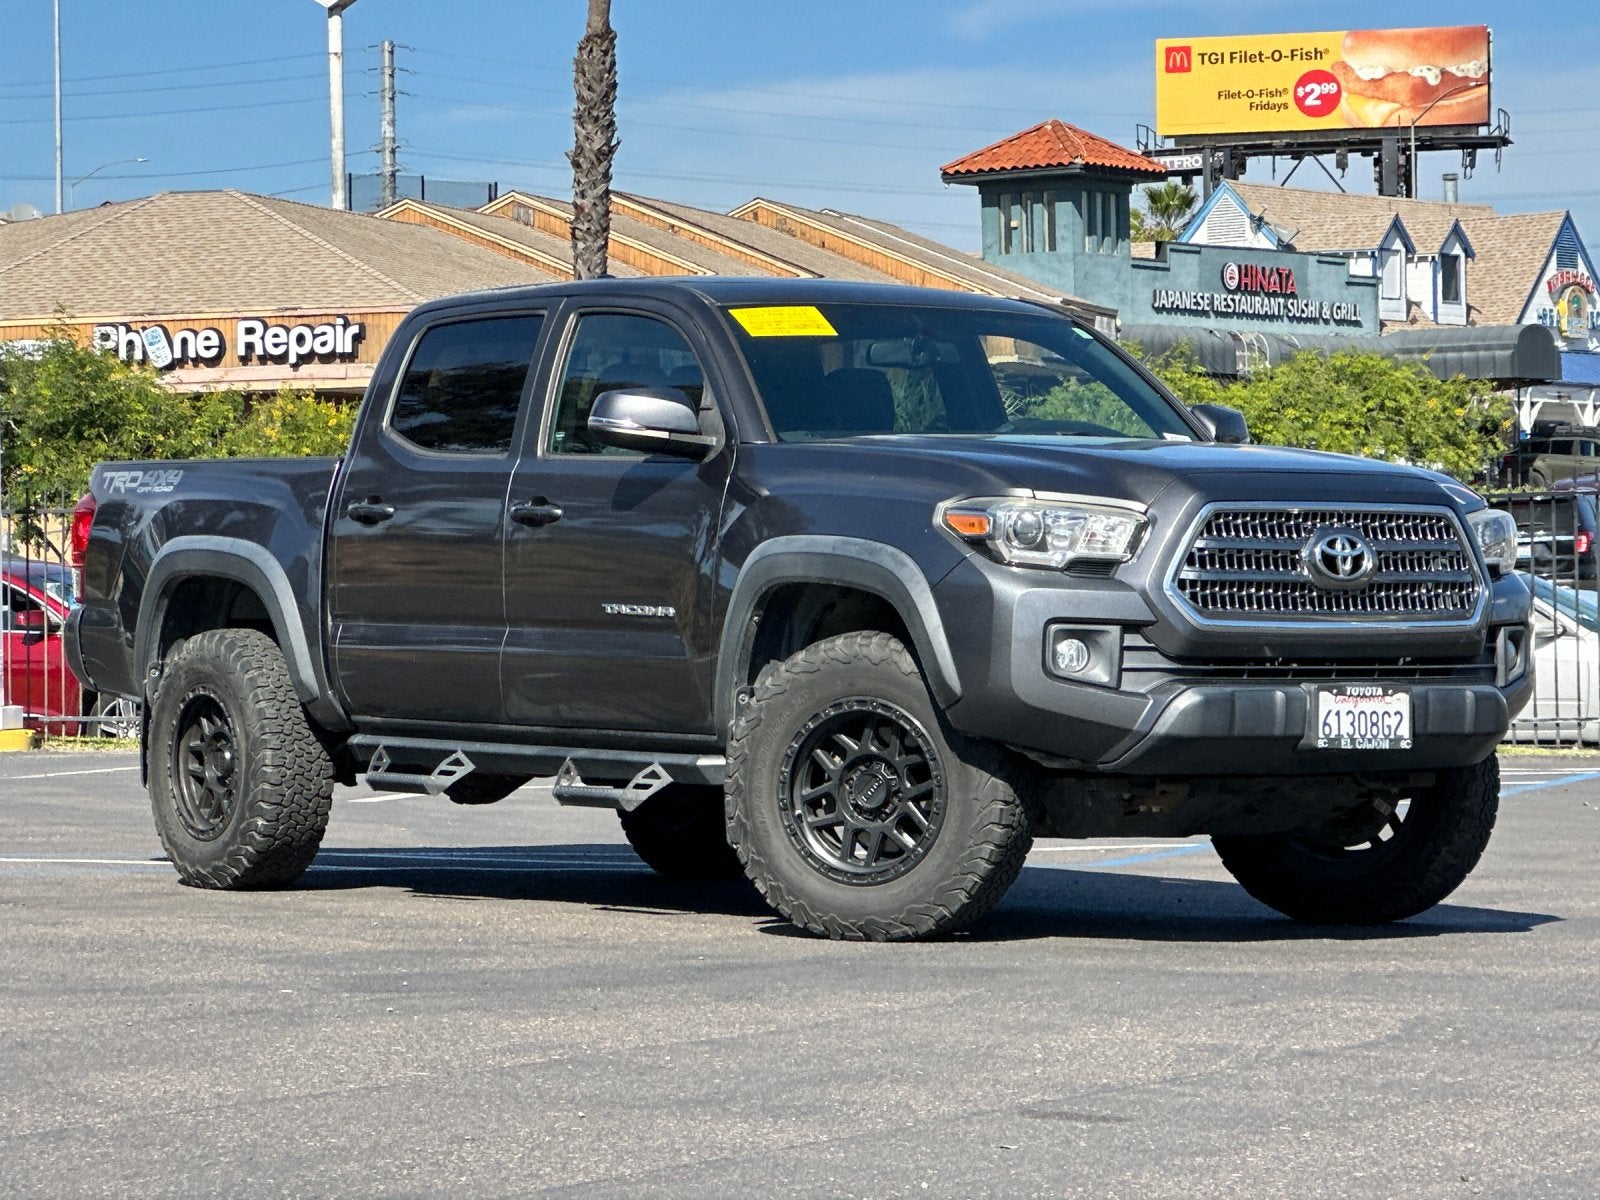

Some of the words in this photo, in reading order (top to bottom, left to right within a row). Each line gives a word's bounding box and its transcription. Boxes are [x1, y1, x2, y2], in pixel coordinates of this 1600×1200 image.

[1198, 52, 1225, 66] TGI
[1249, 100, 1289, 113] Fridays
[1154, 289, 1211, 311] JAPANESE
[1213, 295, 1285, 317] RESTAURANT
[1287, 301, 1319, 319] SUSHI
[1321, 303, 1331, 319] &
[1332, 302, 1362, 321] GRILL
[237, 317, 360, 364] Repair
[601, 603, 676, 617] TACOMA
[1346, 686, 1383, 696] TOYOTA
[1322, 709, 1404, 739] 61308G2
[1341, 739, 1353, 749] EL
[1355, 739, 1390, 749] CAJON
